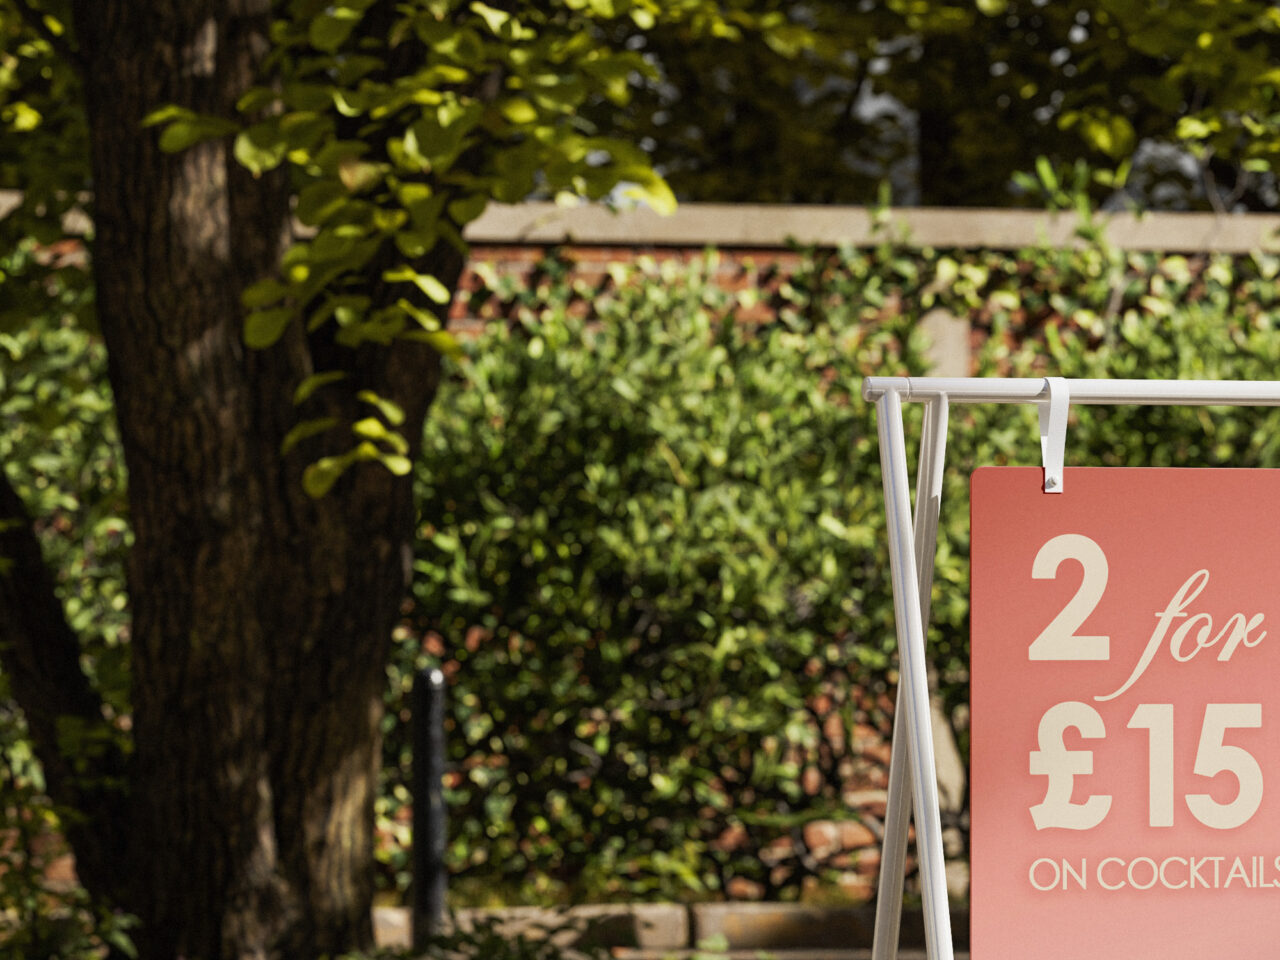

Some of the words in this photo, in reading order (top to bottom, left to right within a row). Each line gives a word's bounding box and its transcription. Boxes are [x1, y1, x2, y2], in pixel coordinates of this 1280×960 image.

[1028, 533, 1110, 661] 2
[1093, 568, 1267, 702] for
[1028, 701, 1264, 831] £15
[1028, 857, 1087, 891] ON
